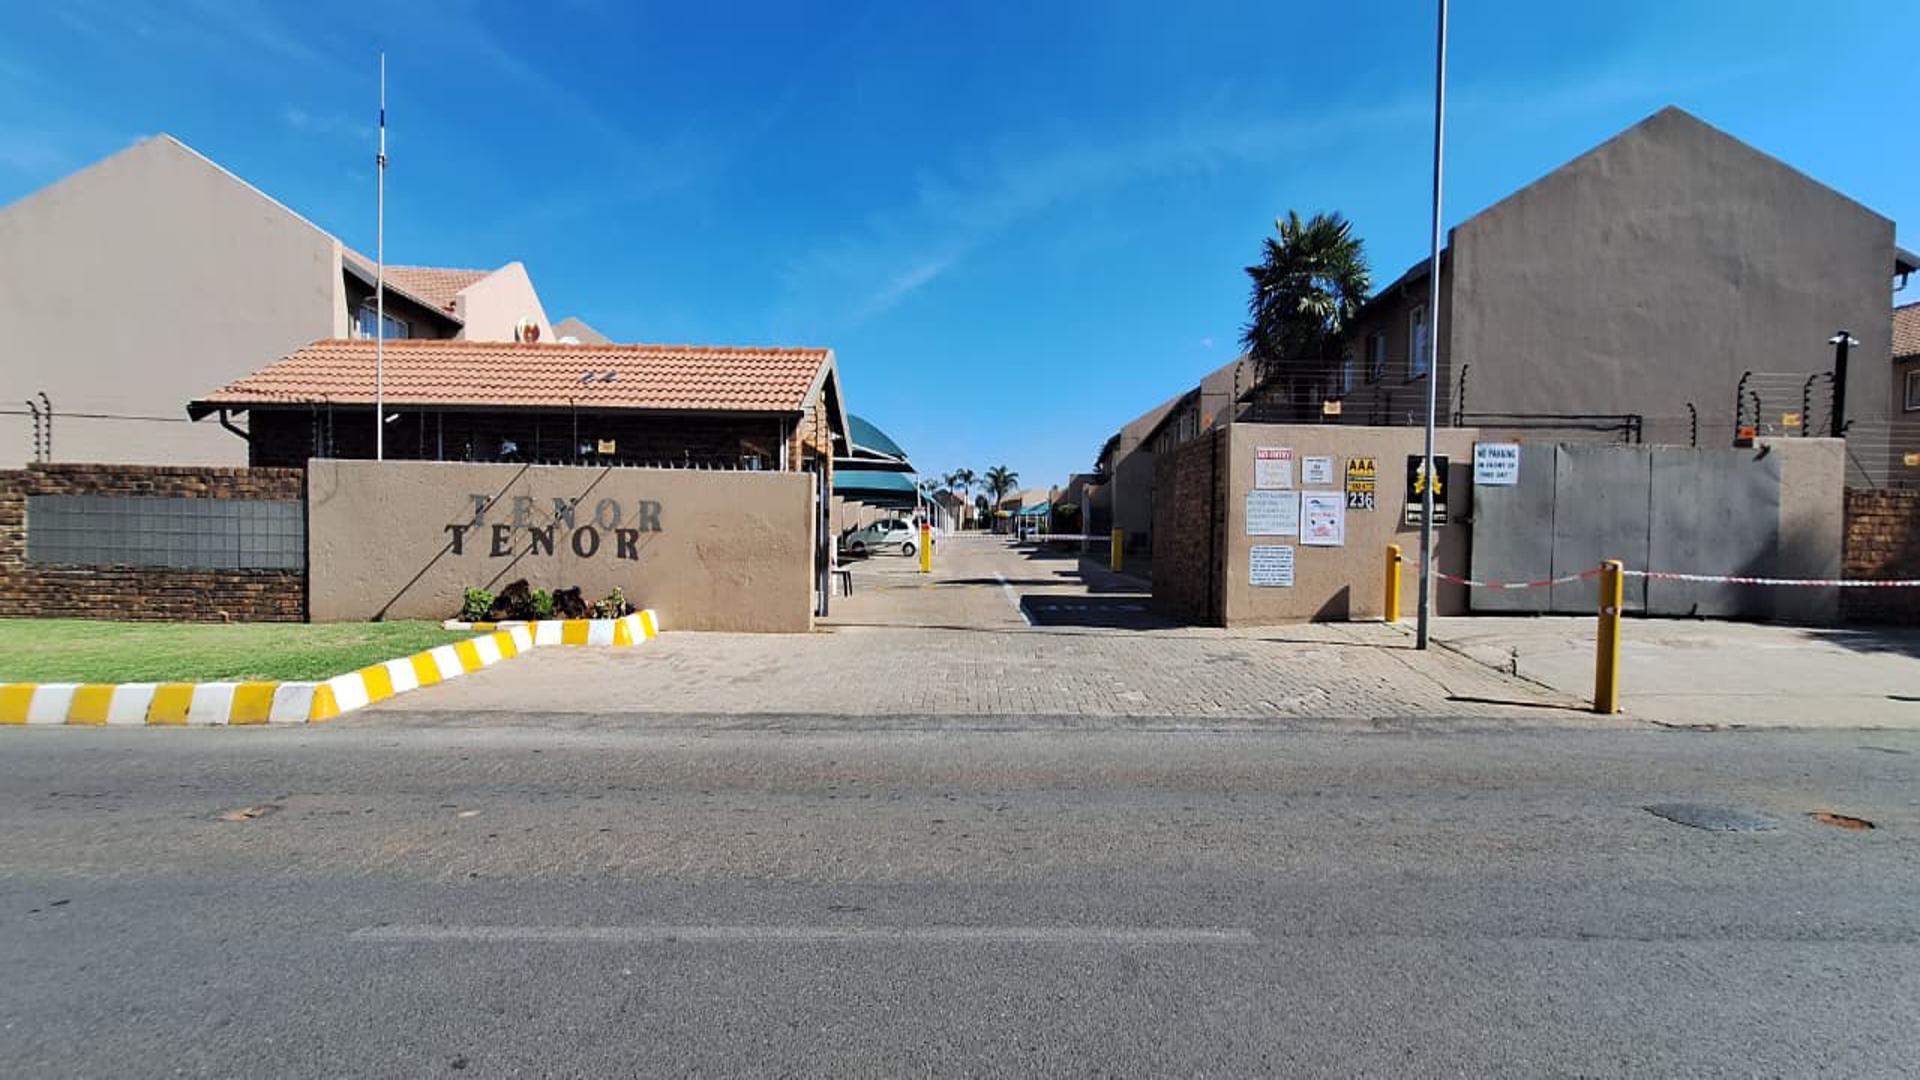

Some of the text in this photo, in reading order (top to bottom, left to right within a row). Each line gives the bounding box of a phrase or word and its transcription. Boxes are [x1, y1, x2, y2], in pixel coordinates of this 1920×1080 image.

[1478, 448, 1516, 458] NO PARKING
[1349, 459, 1375, 470] AAA
[1349, 492, 1373, 510] 236
[469, 493, 663, 532] TENOR
